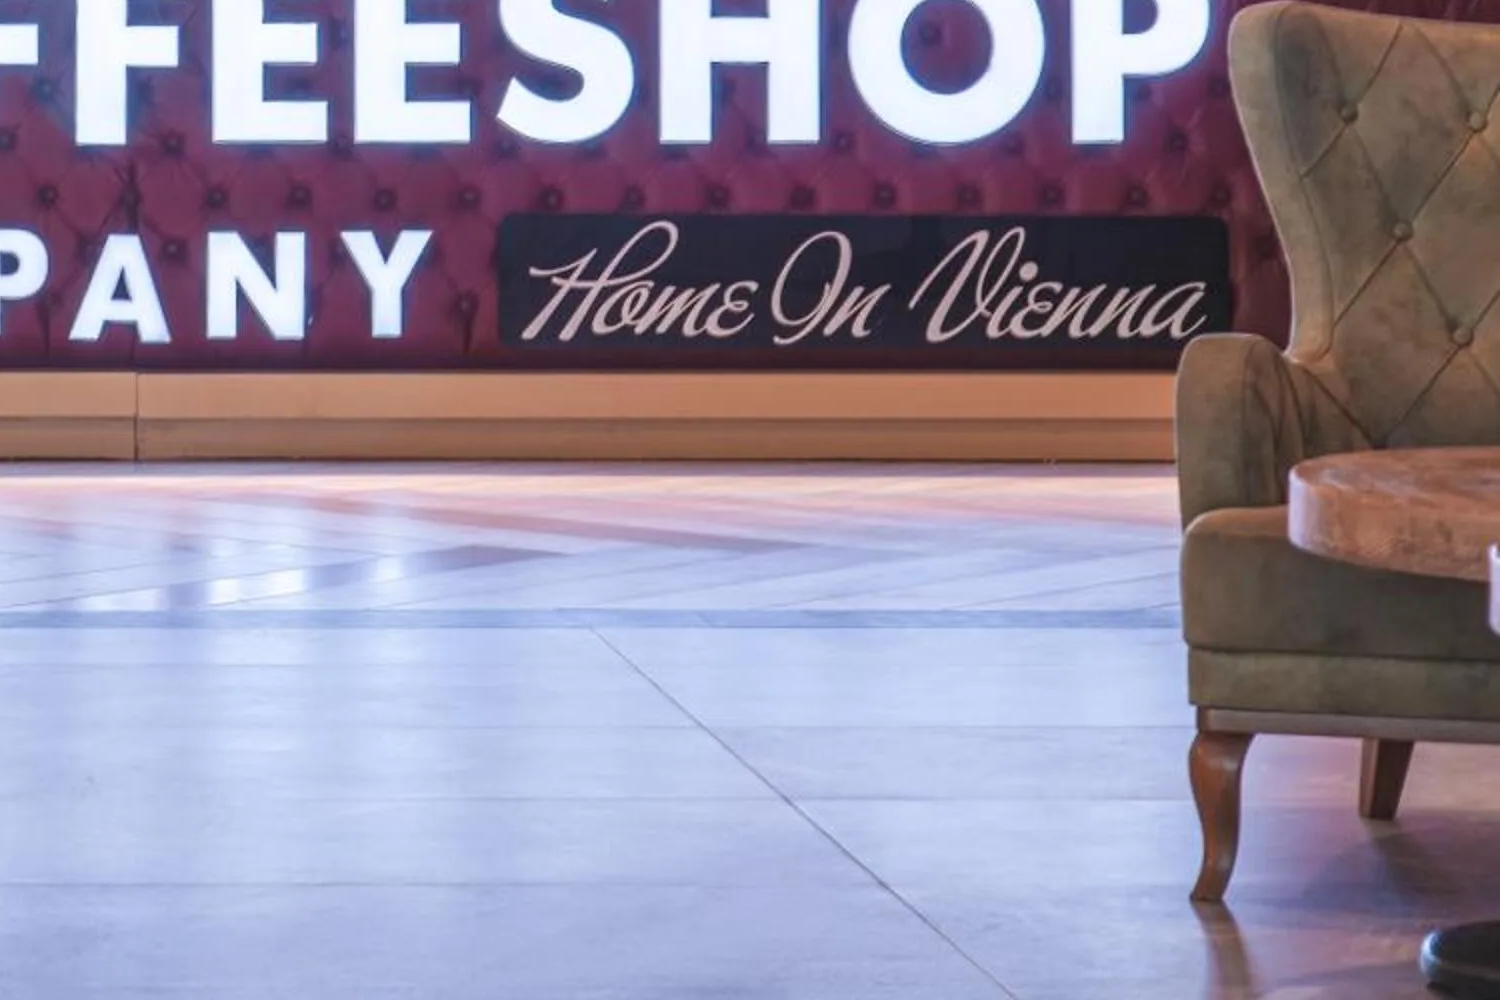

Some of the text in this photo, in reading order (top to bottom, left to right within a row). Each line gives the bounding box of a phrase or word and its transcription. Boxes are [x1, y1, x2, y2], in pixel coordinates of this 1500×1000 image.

[521, 220, 1208, 346] Home In Vienna
